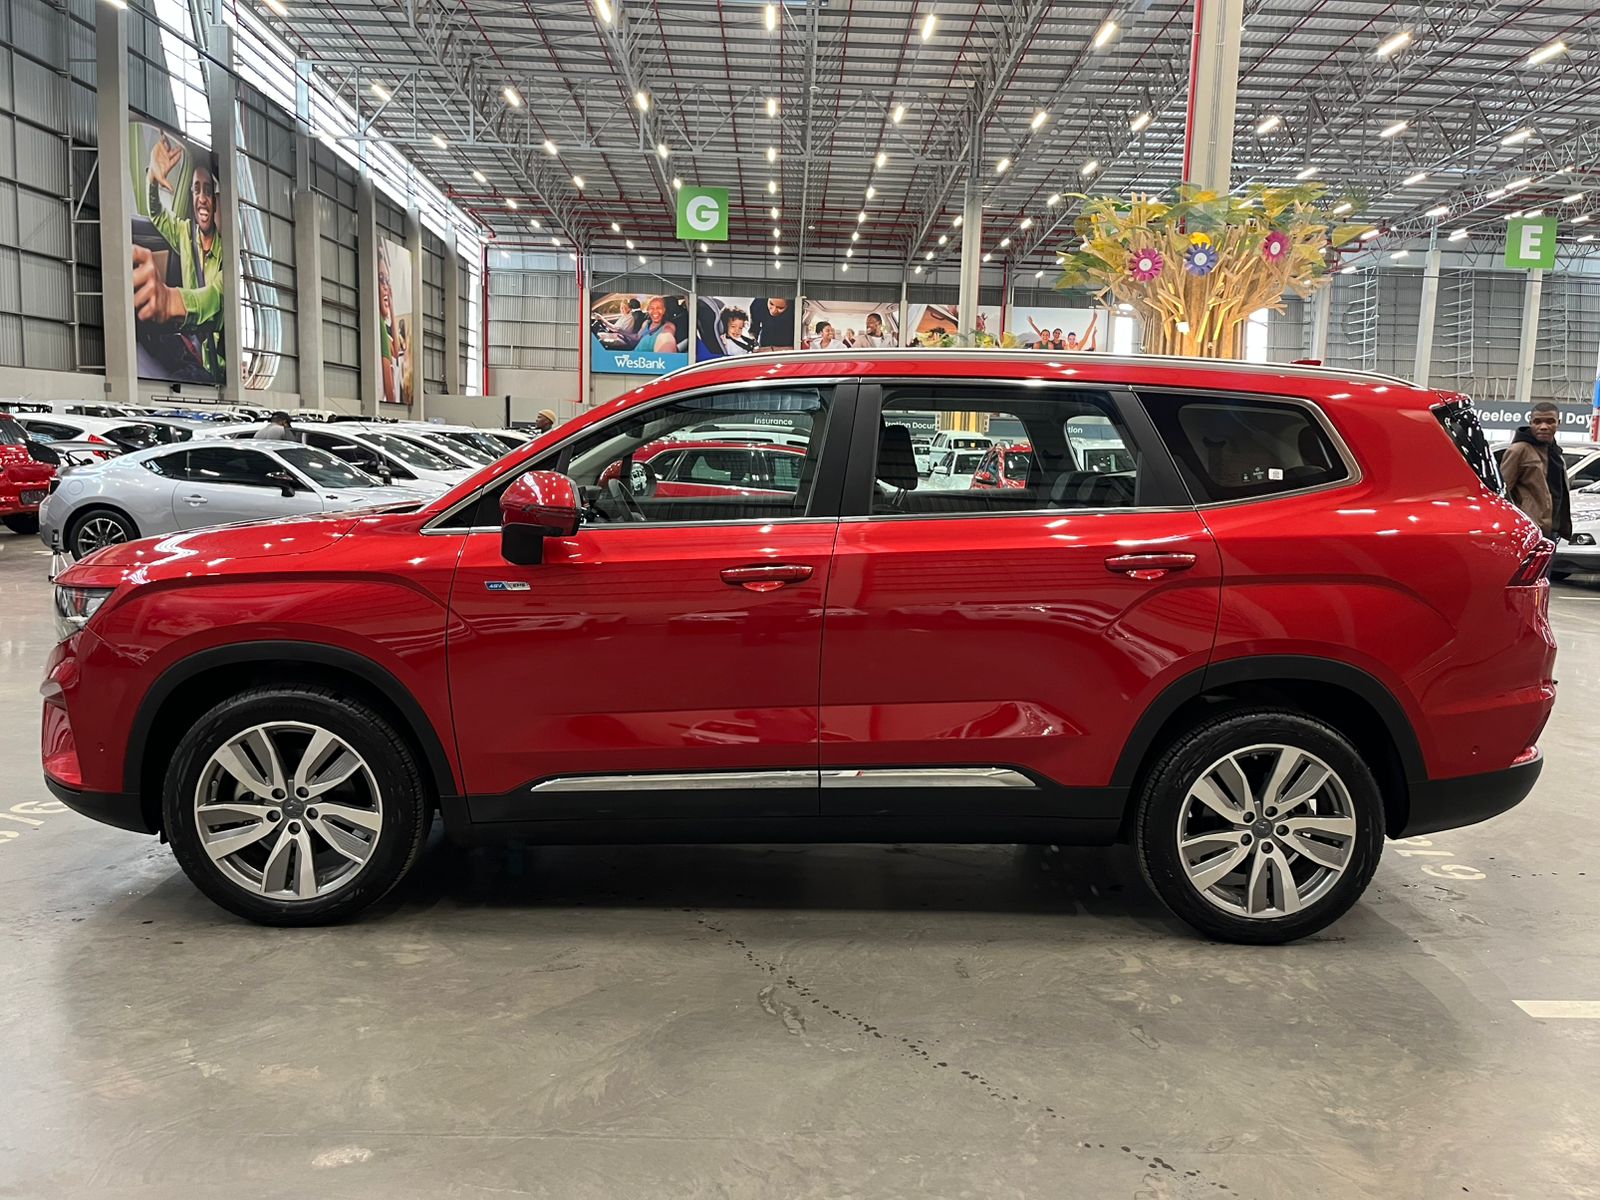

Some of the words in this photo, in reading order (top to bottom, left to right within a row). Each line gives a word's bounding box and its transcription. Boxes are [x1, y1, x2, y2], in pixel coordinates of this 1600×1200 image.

[686, 195, 719, 231] G
[1519, 225, 1543, 259] E
[614, 355, 665, 369] WesBank
[754, 417, 793, 426] Insurance
